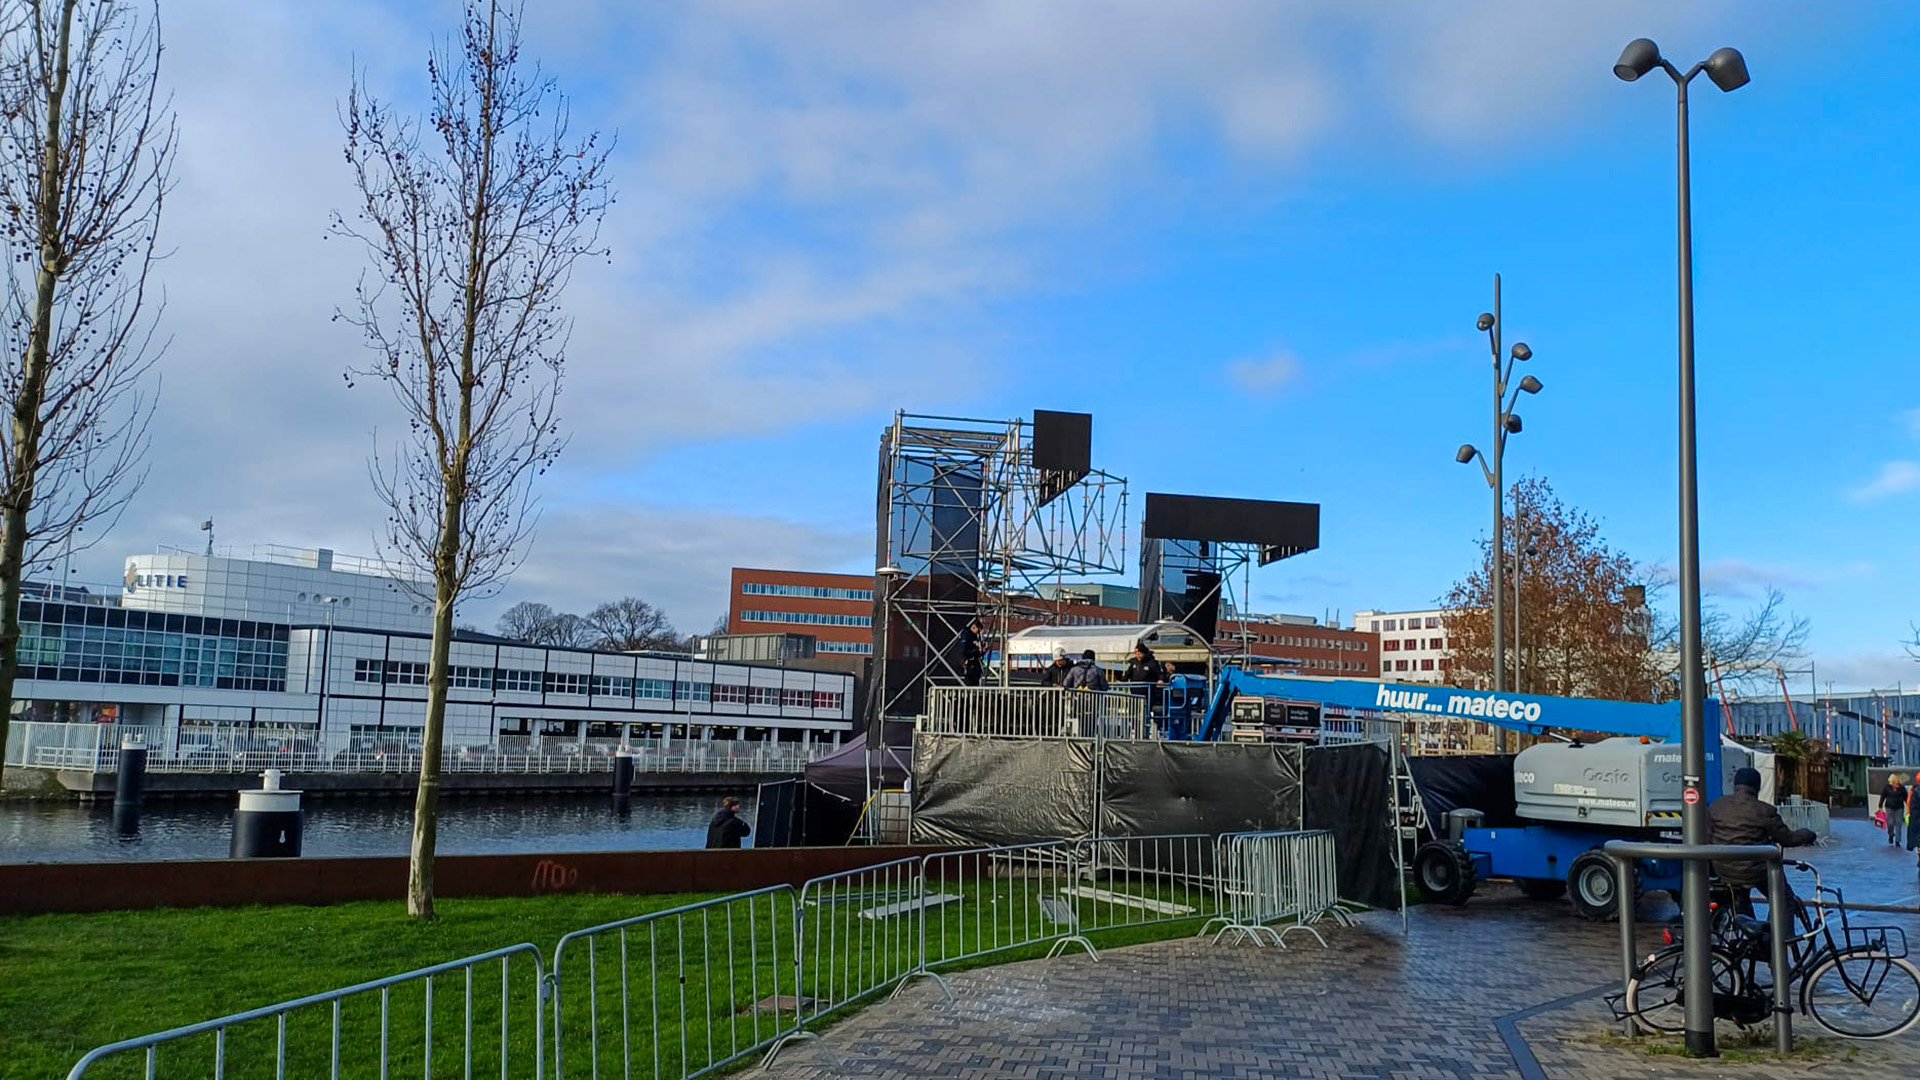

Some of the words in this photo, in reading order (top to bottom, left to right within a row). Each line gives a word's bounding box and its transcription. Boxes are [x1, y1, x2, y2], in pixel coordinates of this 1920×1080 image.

[124, 574, 187, 588] LITIE
[1376, 684, 1442, 712] huur...
[1447, 694, 1541, 722] mateco
[1654, 753, 1682, 763] mate
